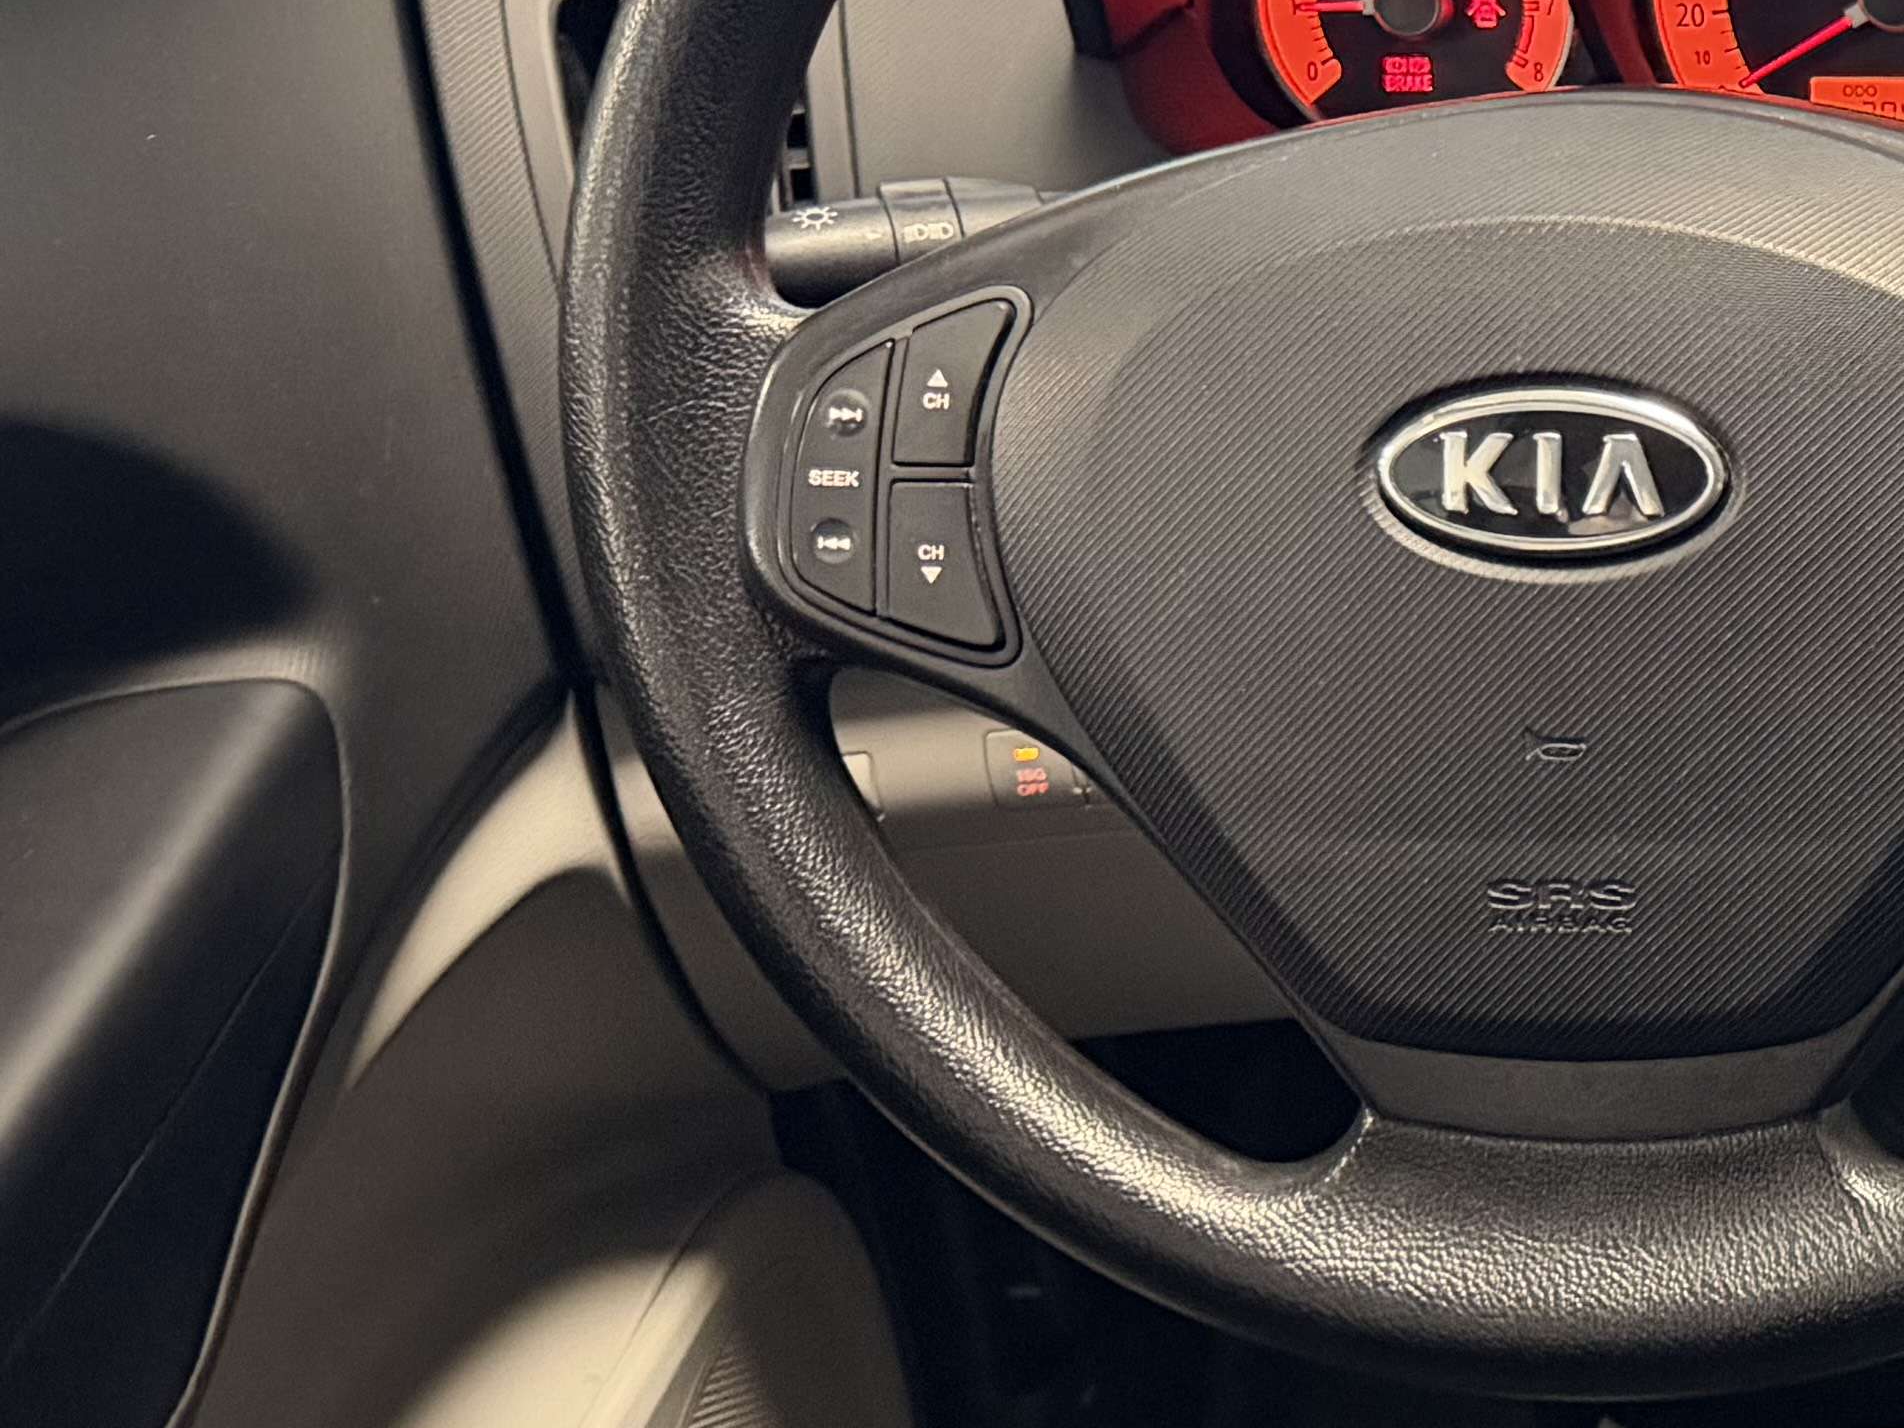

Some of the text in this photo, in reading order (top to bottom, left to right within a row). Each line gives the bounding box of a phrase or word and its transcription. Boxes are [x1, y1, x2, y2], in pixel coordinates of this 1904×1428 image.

[1676, 3, 1705, 27] 20
[1694, 50, 1711, 65] 10
[1307, 62, 1318, 81] 0
[1533, 62, 1544, 82] 8
[1384, 74, 1433, 92] BRAKE
[1843, 84, 1878, 98] ODO
[923, 392, 950, 410] CH
[808, 469, 860, 487] SEEK
[1438, 430, 1664, 517] KIA
[918, 544, 945, 560] CH
[1488, 879, 1637, 910] SRS
